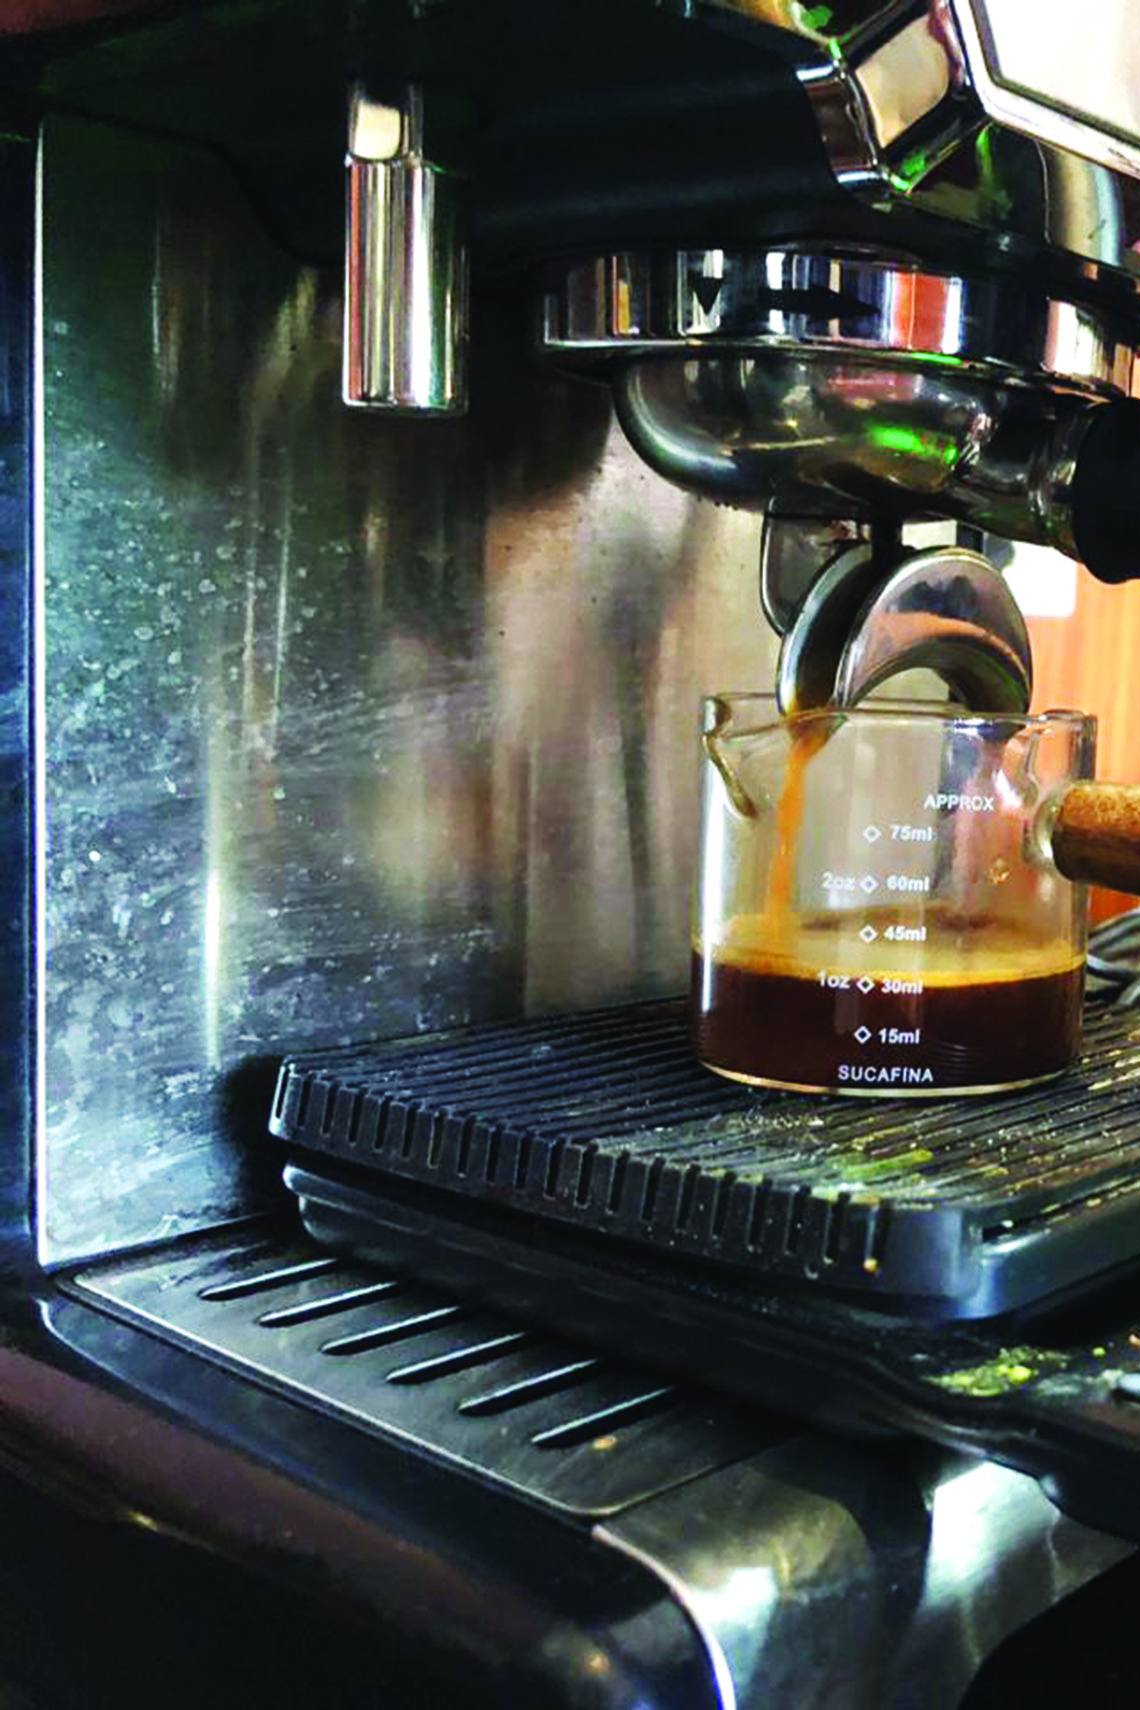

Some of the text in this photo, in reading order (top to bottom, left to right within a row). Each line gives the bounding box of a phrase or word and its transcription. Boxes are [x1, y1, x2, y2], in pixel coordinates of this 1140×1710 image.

[923, 794, 995, 812] APPROX
[890, 825, 933, 842] 75ml
[822, 872, 931, 891] 2oz 60ml
[883, 926, 927, 942] 45ml
[817, 969, 924, 995] 1oz 30ml
[878, 1028, 921, 1045] 15ml
[837, 1064, 935, 1083] SUCAFINA
